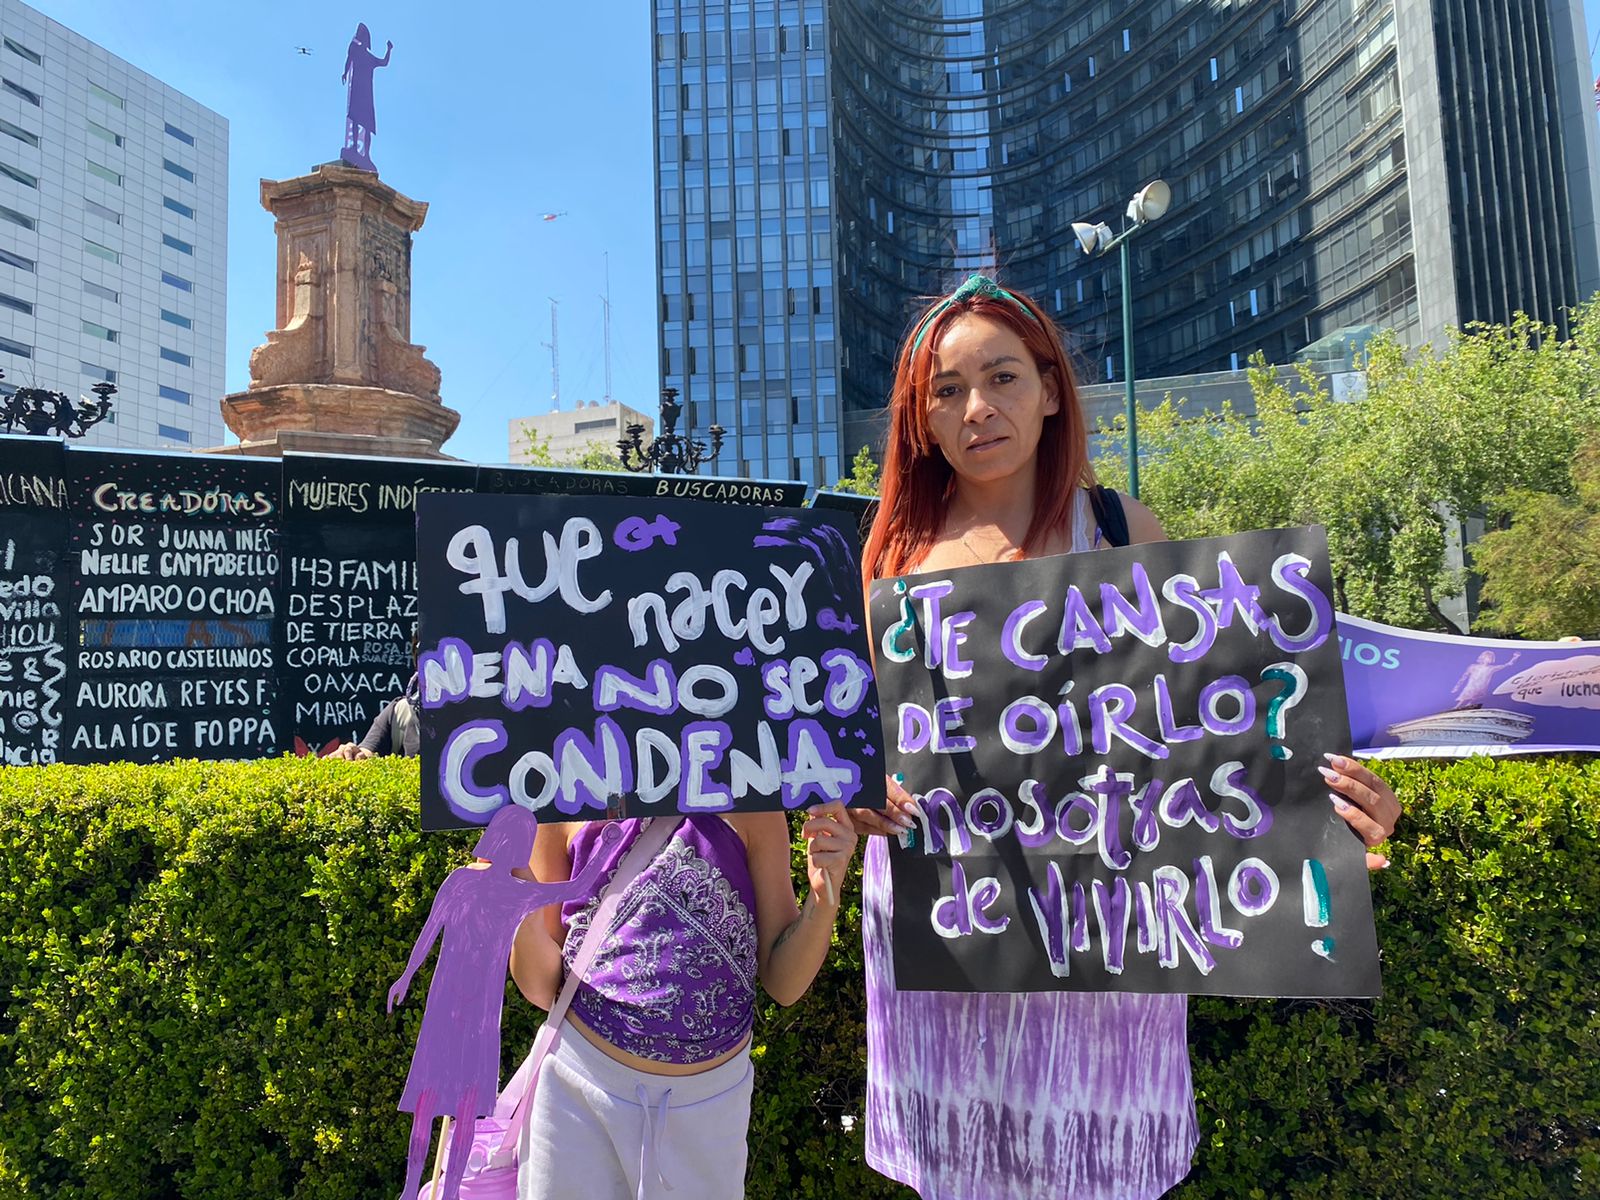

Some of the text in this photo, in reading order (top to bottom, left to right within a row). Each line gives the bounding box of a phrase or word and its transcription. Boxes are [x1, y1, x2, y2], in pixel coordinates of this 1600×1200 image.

[0, 474, 70, 510] ICANA
[289, 475, 371, 513] MUJERES
[656, 479, 784, 502] BUSCADORAS
[90, 522, 275, 552] SOR JUANA INÉS
[81, 549, 279, 578] NELLIE CAMPOBELLO
[291, 557, 333, 588] 143
[78, 583, 275, 614] AMPARO OCHOA
[288, 593, 419, 620] DESPLAZ
[1000, 550, 1335, 671] CANSAS
[286, 621, 316, 643] DE
[322, 621, 404, 642] TIERRA
[78, 647, 274, 670] ROSARIO CASTELLANOS
[286, 645, 360, 669] COPALA
[1337, 635, 1400, 670] IOS
[304, 672, 404, 694] OAXACA
[421, 637, 588, 708] NENA
[593, 657, 739, 718] NO
[76, 680, 168, 709] AURORA
[180, 678, 250, 708] REYES
[295, 694, 367, 726] MARÍA
[897, 696, 976, 754] DE
[71, 714, 276, 751] ALAÍDE FOPPA
[439, 713, 862, 824] CONDENA
[931, 860, 1011, 939] de
